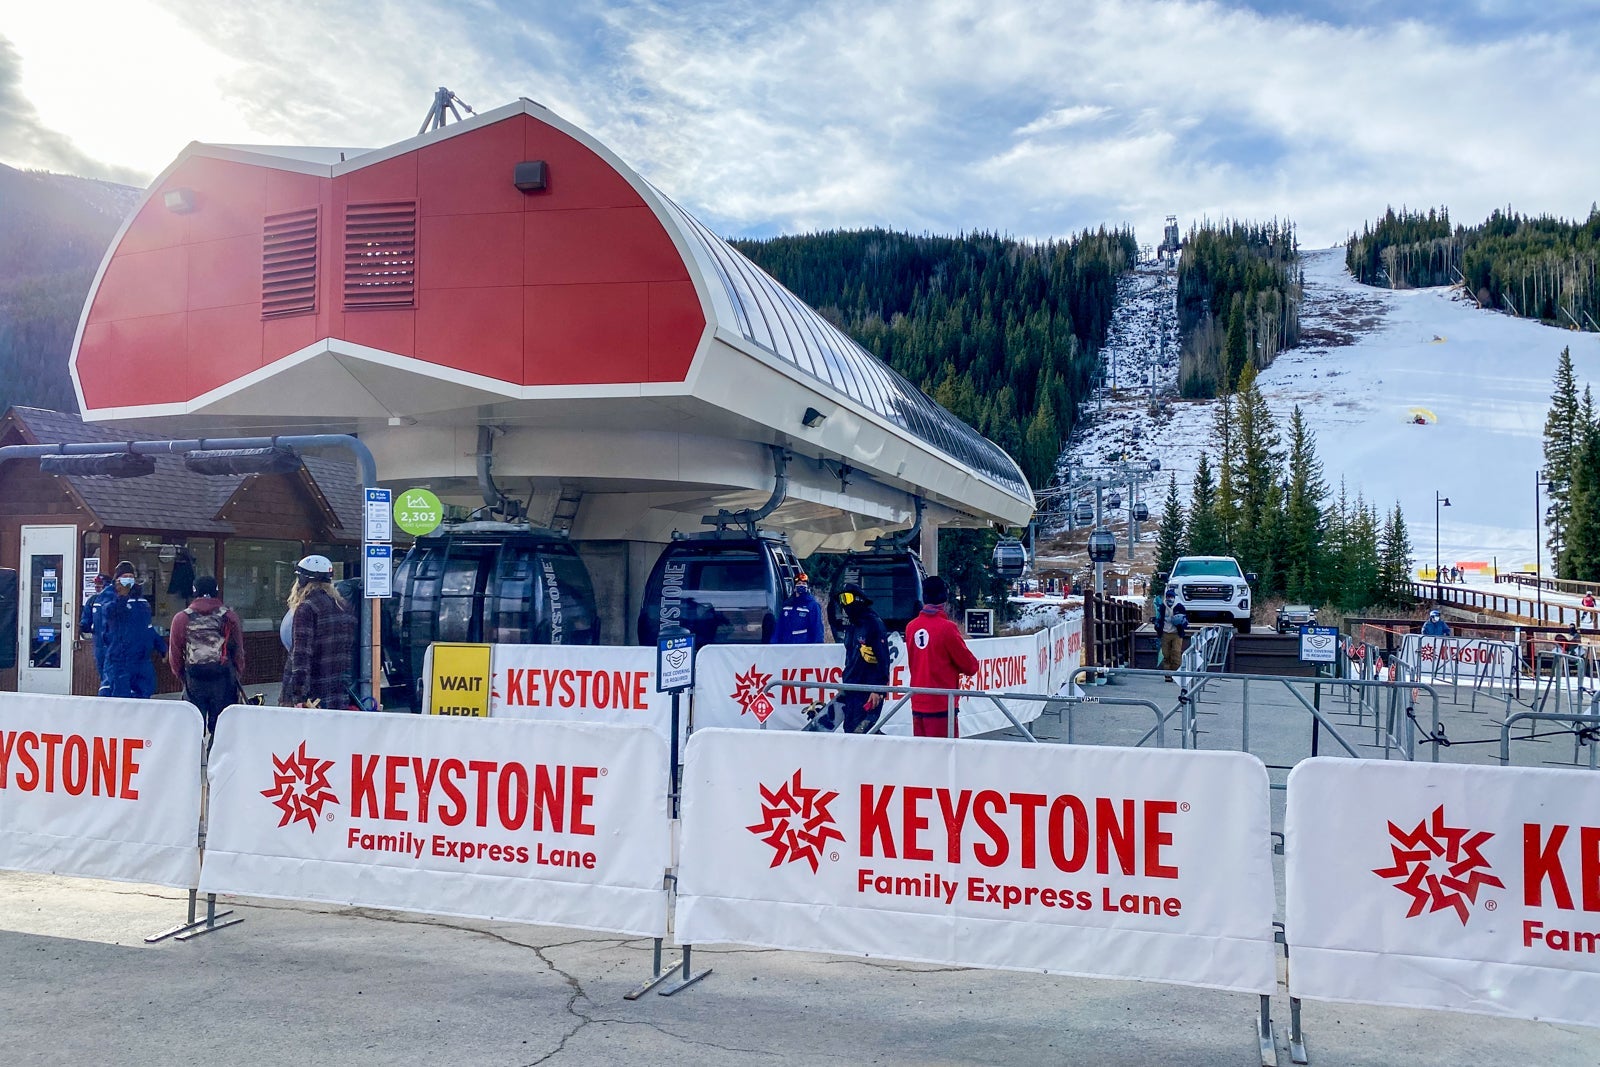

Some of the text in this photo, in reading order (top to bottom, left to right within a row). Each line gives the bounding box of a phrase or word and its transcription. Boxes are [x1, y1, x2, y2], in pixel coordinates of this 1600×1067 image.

[401, 512, 436, 523] 2,303
[541, 562, 563, 645] EYSTONE
[660, 563, 686, 630] YSTONE
[439, 676, 483, 692] WAIT
[507, 668, 649, 710] KEYSTONE
[977, 655, 1027, 691] KEYSTONE
[350, 754, 598, 836] KEYSTONE
[347, 828, 597, 869] Family Express Lane
[860, 784, 1179, 879] KEYSTONE
[858, 869, 1182, 917] Family Express Lane
